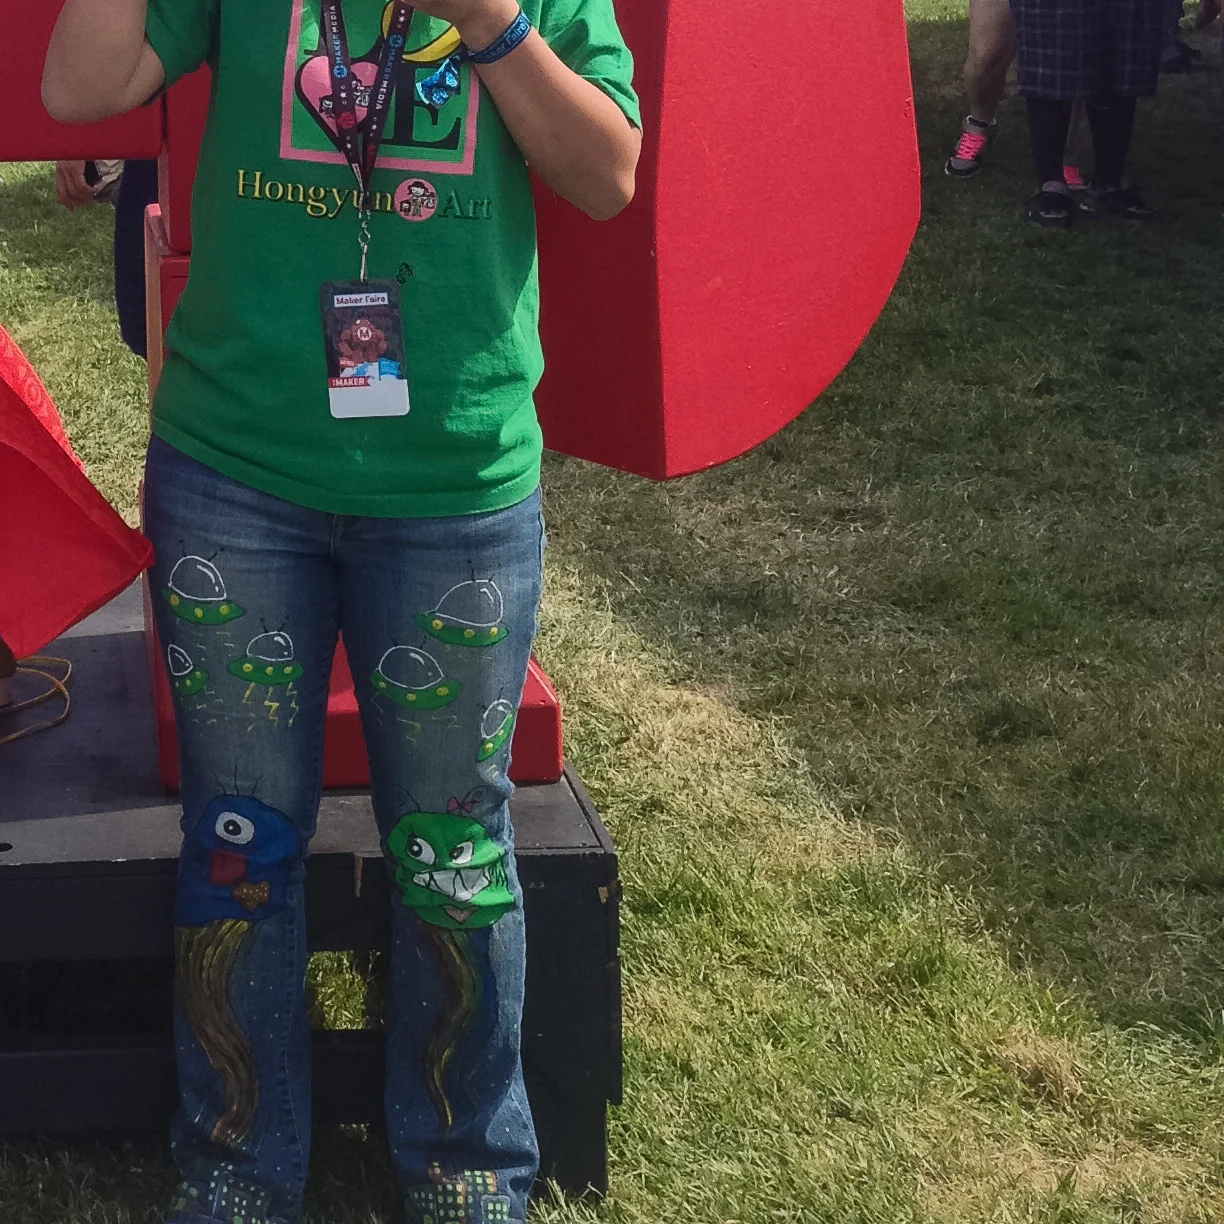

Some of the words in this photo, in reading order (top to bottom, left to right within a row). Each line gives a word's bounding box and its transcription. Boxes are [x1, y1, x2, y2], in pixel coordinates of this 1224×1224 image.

[330, 5, 339, 34] MEDIA
[376, 80, 389, 110] MEDIA
[438, 188, 492, 220] Art
[335, 296, 363, 306] Maker
[365, 295, 387, 305] Faire
